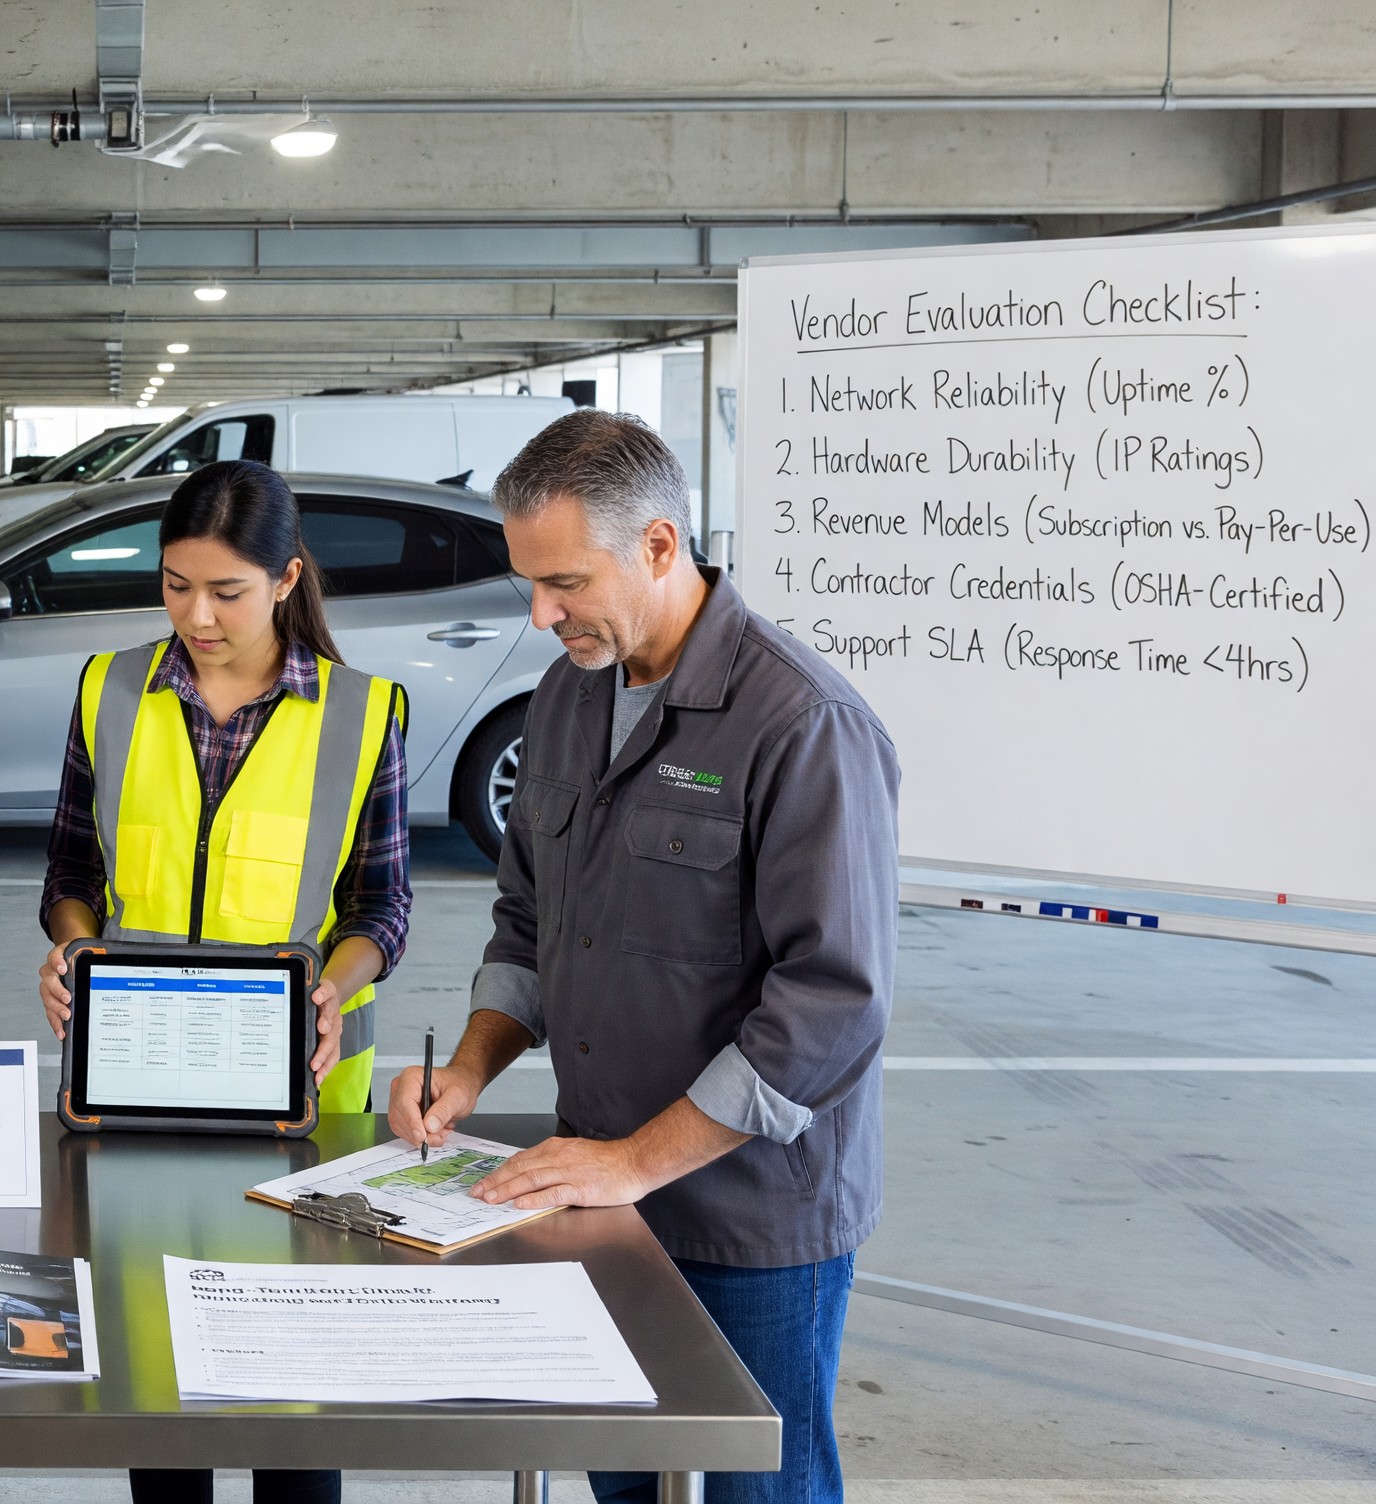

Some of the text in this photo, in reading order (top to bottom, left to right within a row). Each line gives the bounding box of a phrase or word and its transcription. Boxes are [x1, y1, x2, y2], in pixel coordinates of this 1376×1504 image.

[791, 276, 1261, 341] Vendor Evaluation Checklist:
[781, 354, 1250, 424] 1. Network Reliability (Uptime %)
[775, 426, 1264, 491] 2. Hardware Durability (IP Ratings)
[774, 494, 1371, 554] 3. Revenue Models (Subscription vs. Pay-Per-Use)
[775, 556, 1345, 622] 4. Contractor Credentials (OSHA-Certified)
[813, 618, 912, 671] Support
[928, 626, 985, 664] SLA
[1005, 622, 1121, 681] (Response
[1128, 638, 1190, 676] Time
[1203, 636, 1309, 692] <4hrs)
